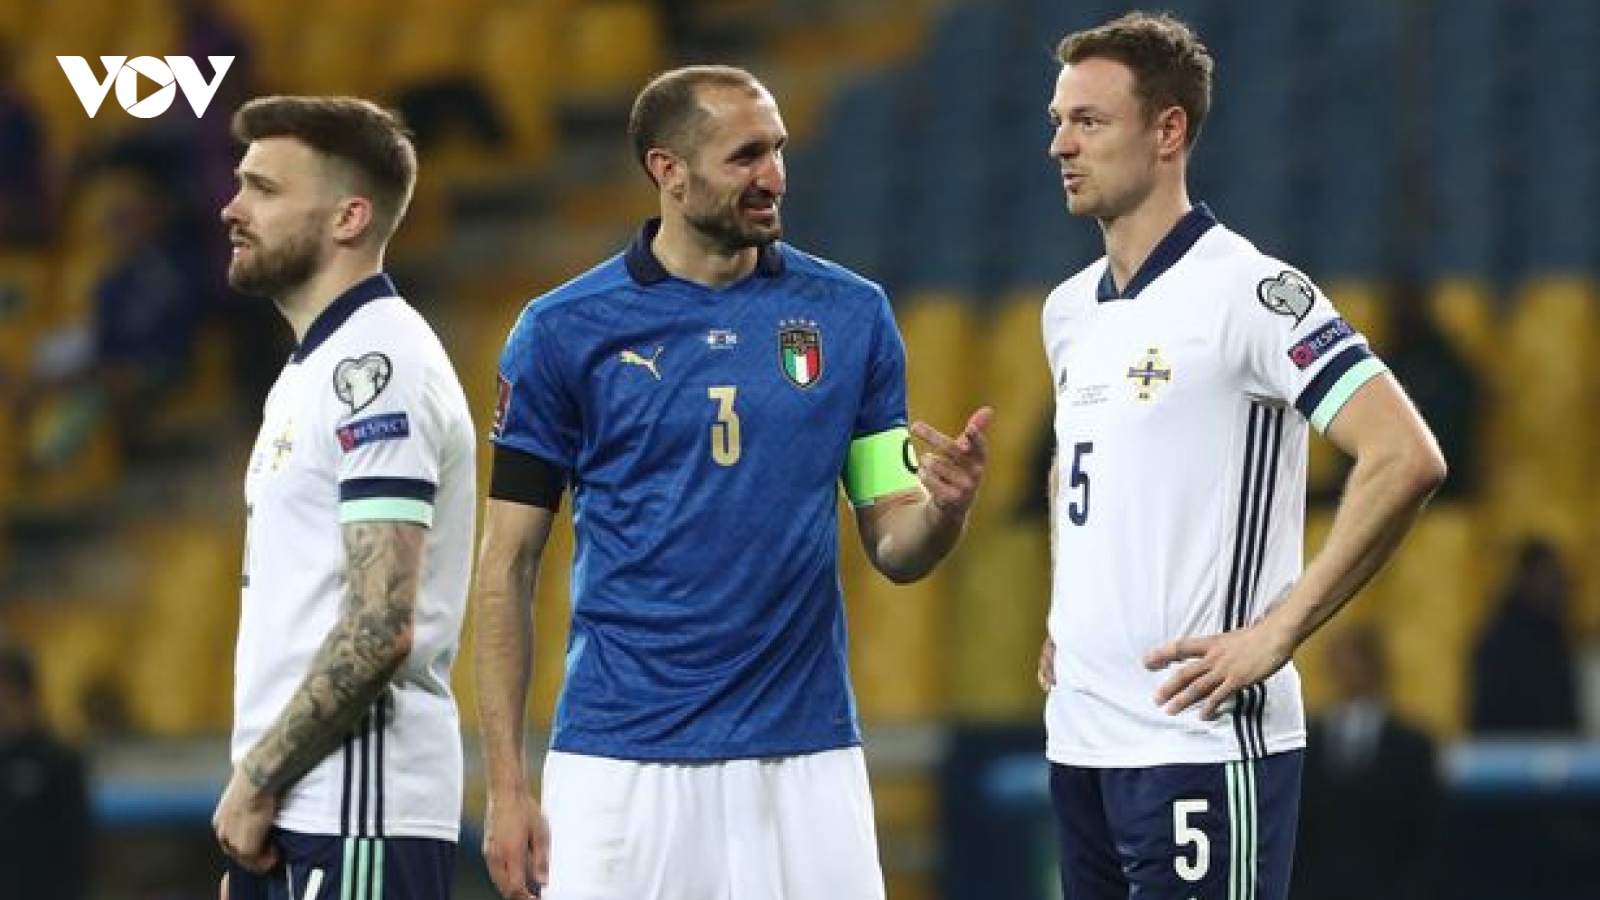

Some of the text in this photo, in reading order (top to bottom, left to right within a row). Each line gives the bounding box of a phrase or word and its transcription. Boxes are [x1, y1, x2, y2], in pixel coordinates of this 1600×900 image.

[707, 385, 741, 466] 3
[1069, 441, 1094, 526] 5
[1173, 799, 1210, 882] 5
